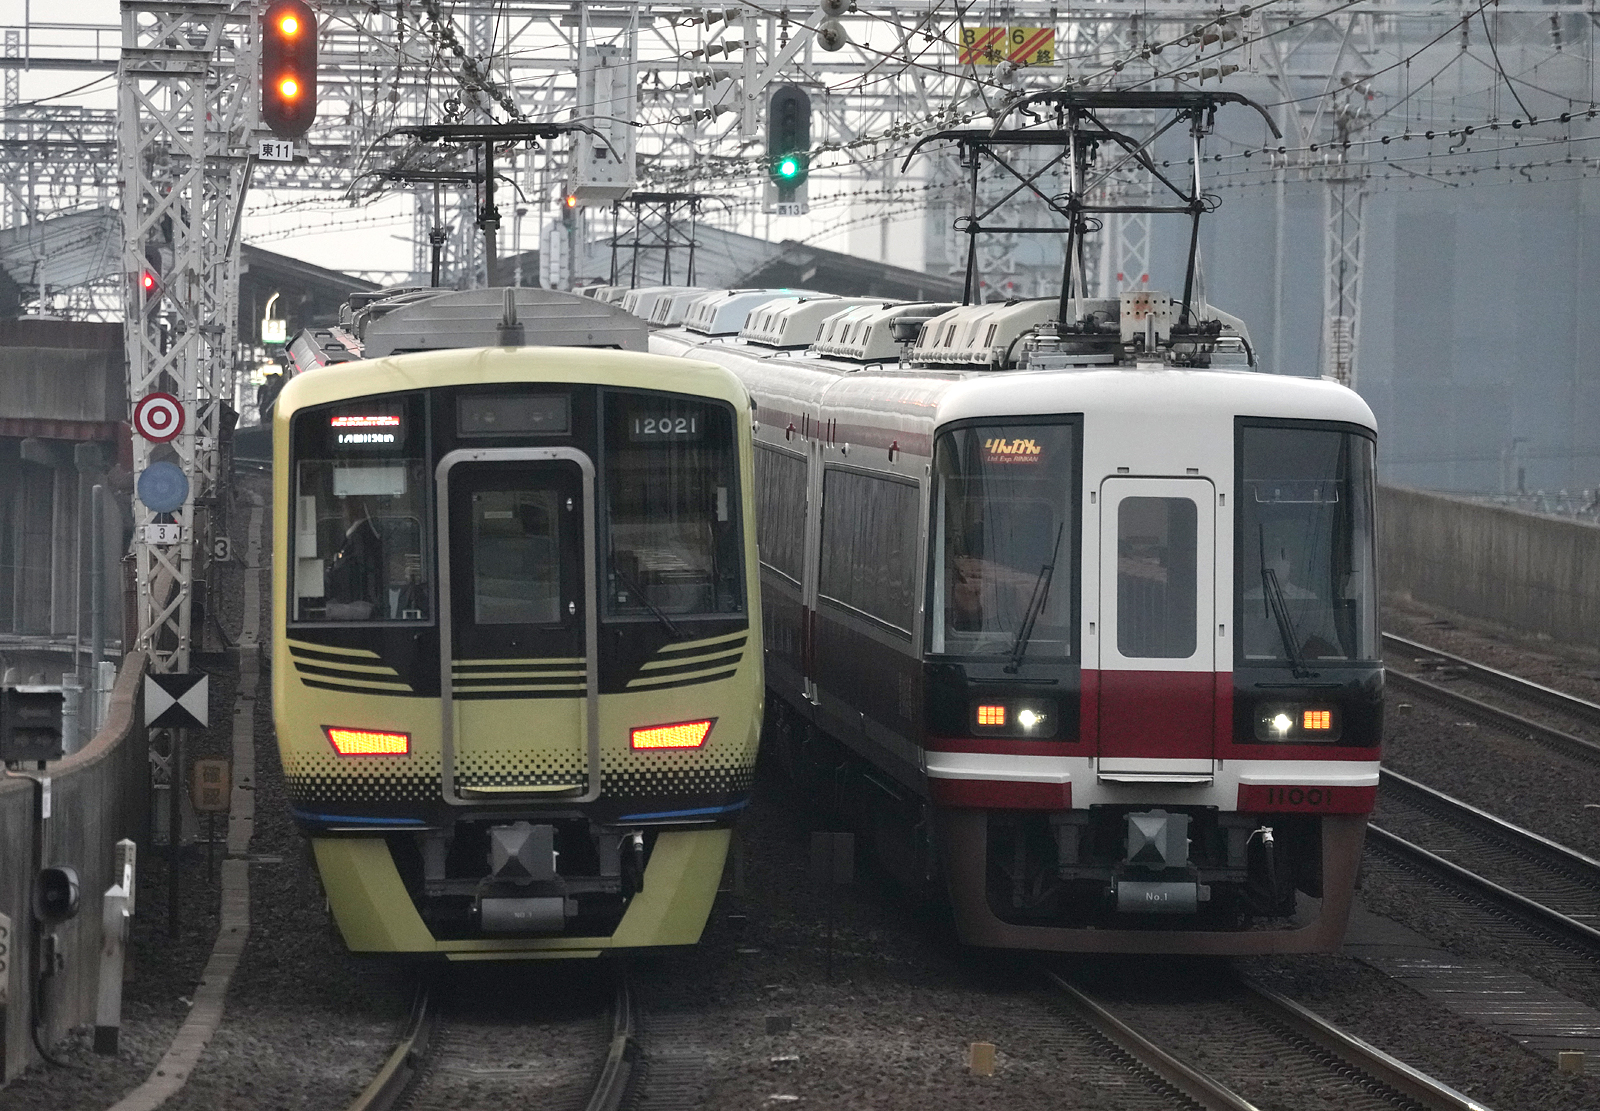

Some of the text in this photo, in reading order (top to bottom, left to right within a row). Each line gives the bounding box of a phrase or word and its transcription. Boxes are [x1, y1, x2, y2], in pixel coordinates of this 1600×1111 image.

[1012, 29, 1025, 44] 6
[262, 143, 289, 158] 東11
[778, 204, 800, 215] 西13
[635, 417, 696, 434] 12021
[985, 438, 1041, 455] りんかん
[1013, 455, 1039, 463] RINKAN
[159, 527, 166, 540] 3
[214, 539, 228, 559] 3
[1268, 787, 1332, 806] 11001
[1145, 892, 1168, 901] No.1
